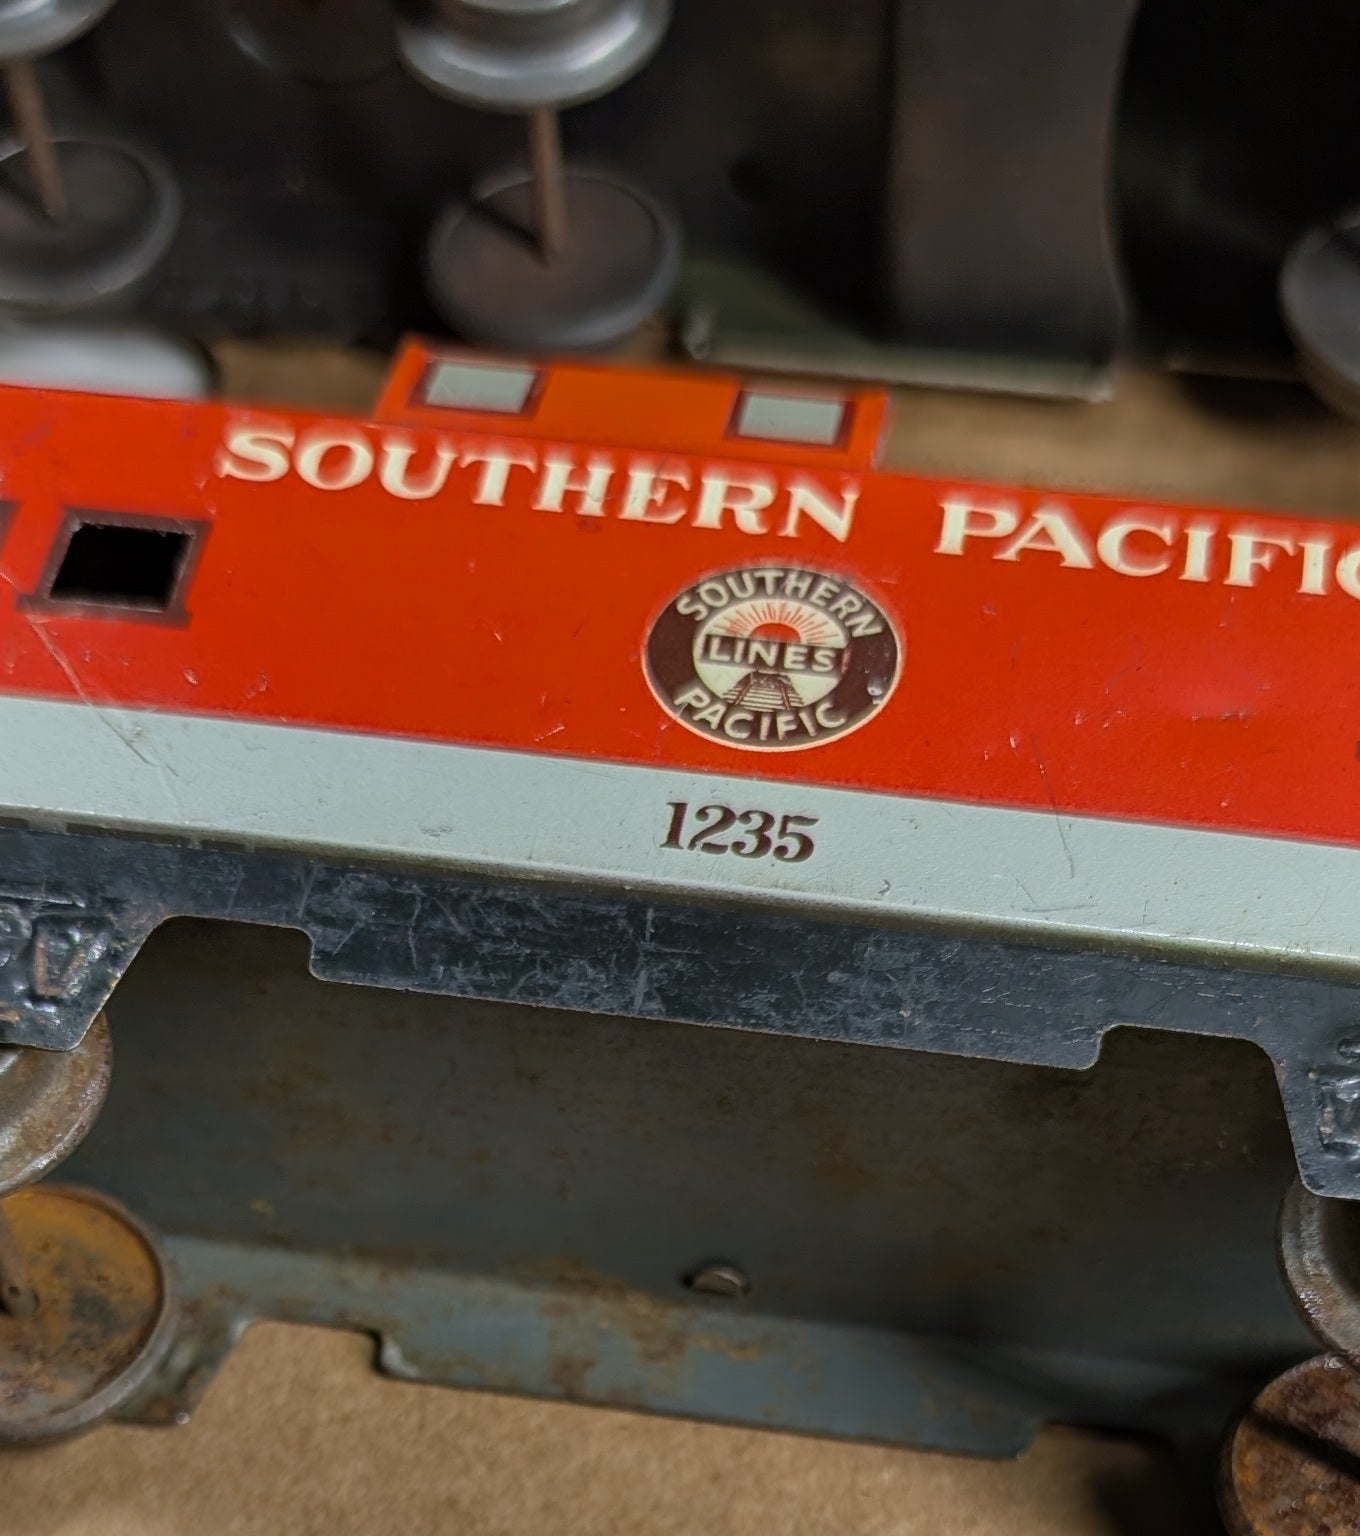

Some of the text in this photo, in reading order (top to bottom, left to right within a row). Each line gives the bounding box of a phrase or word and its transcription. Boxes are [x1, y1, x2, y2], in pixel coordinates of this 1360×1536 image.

[219, 428, 860, 542] SOUTHERN
[676, 569, 883, 638] SOUTHERN
[708, 636, 837, 673] LINES
[674, 686, 847, 741] PACIFIC
[659, 802, 819, 863] 1235
